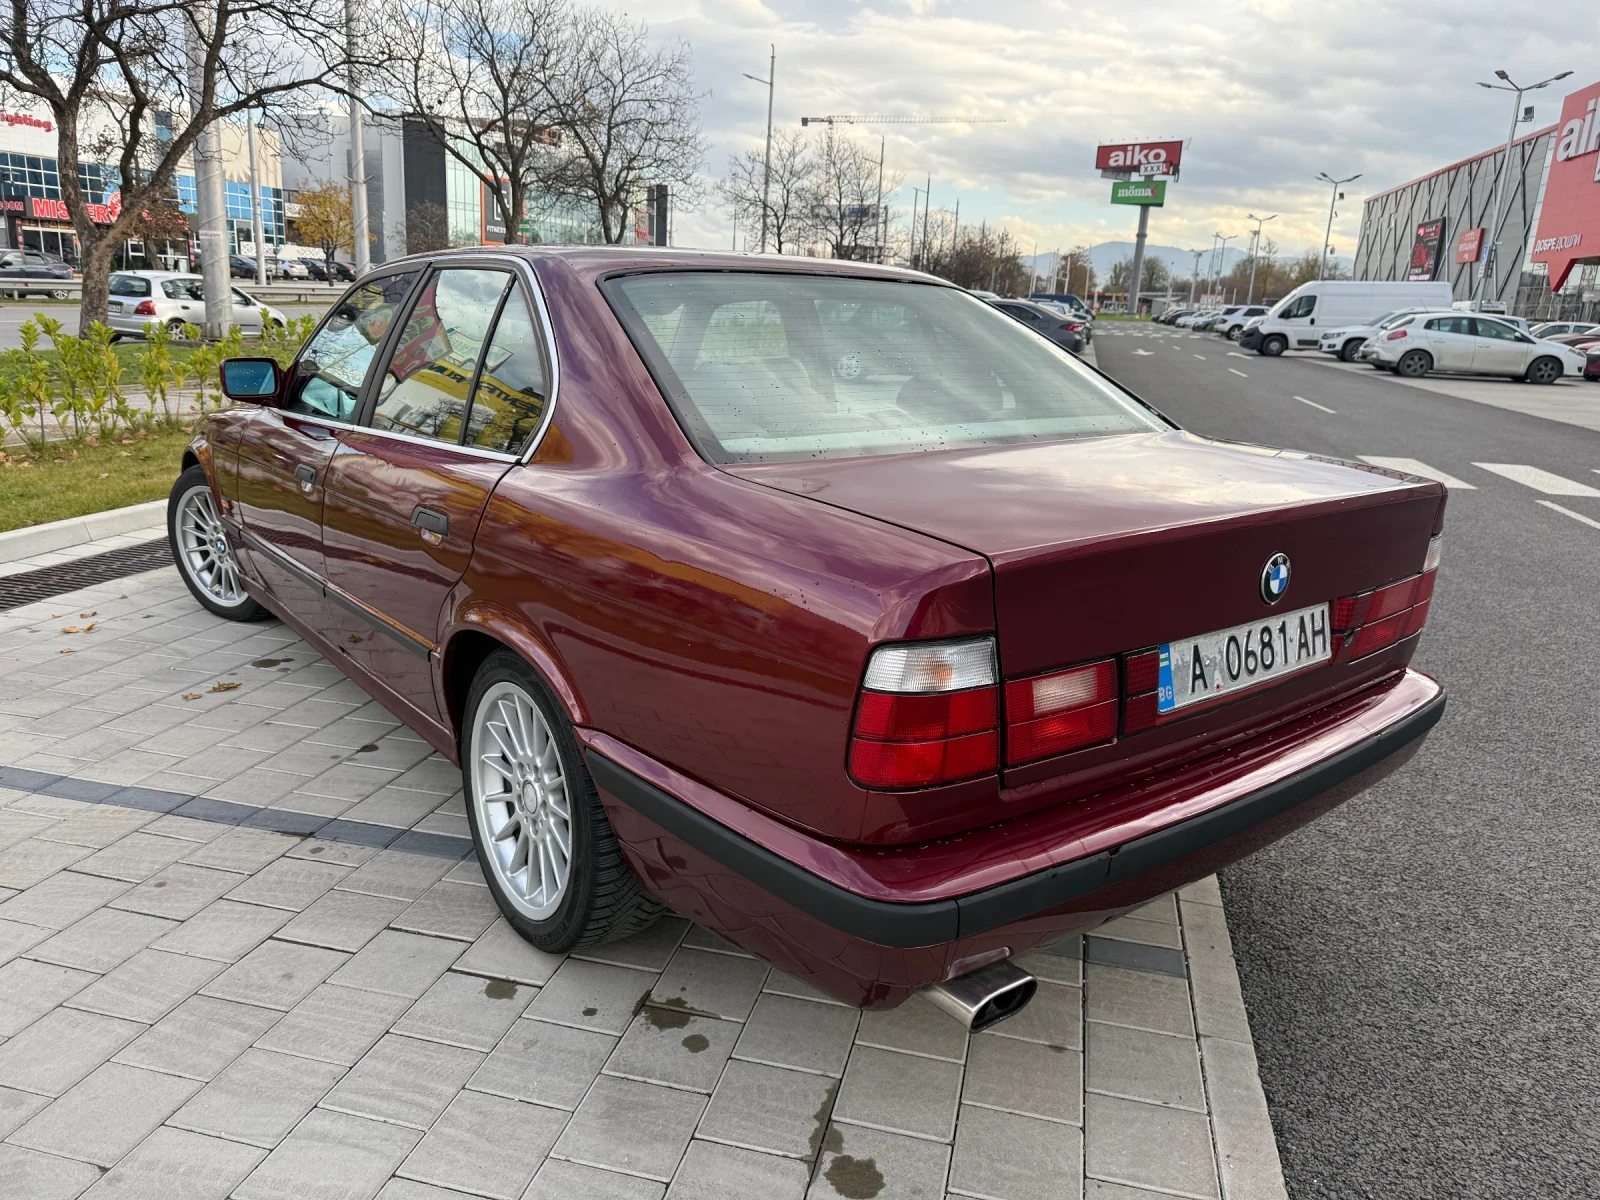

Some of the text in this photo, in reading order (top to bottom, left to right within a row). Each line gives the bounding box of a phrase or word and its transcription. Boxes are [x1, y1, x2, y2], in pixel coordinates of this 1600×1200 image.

[1109, 145, 1166, 167] aiko
[1143, 163, 1168, 173] XXXL
[32, 198, 110, 223] MISER
[1534, 233, 1582, 254] ДОБРЕ ДОШЛИ
[1267, 555, 1290, 574] BMW
[1189, 608, 1327, 696] A 0681 AH
[1157, 685, 1174, 703] BG
